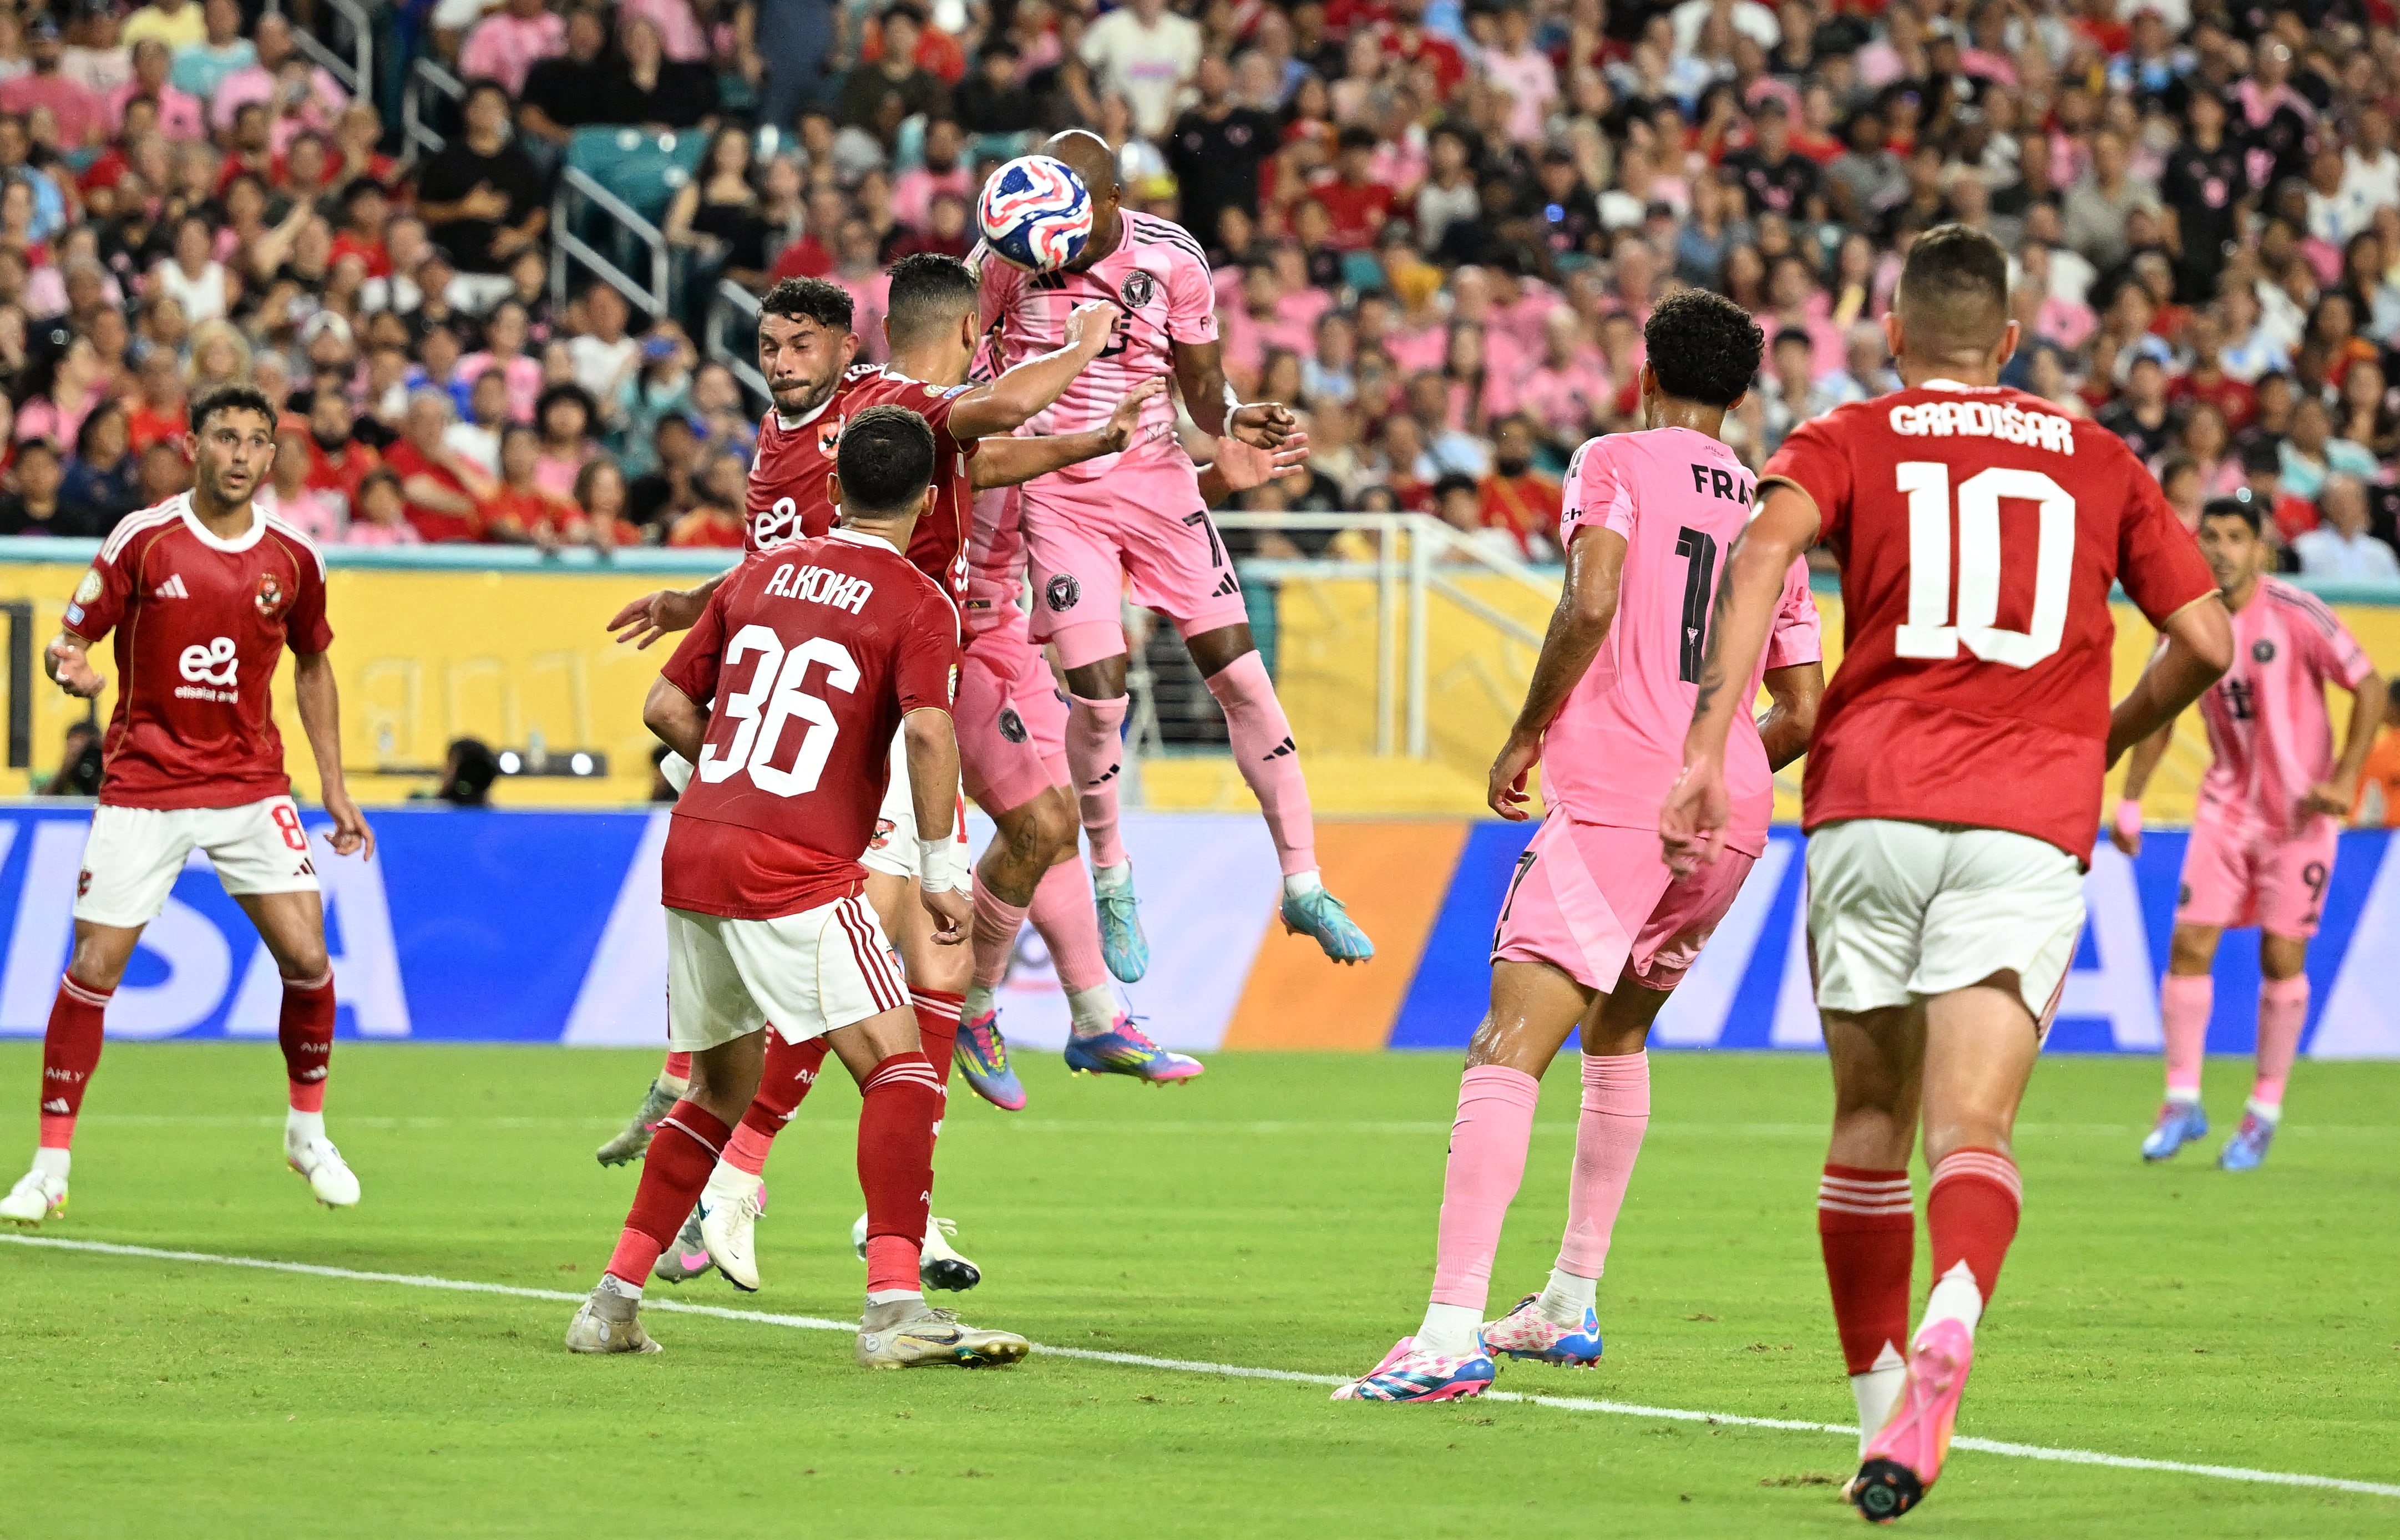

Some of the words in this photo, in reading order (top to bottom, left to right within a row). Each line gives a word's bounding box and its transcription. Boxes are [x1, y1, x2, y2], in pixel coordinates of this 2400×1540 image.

[1888, 401, 2075, 456] GRADIŠAR
[1181, 510, 1222, 568] 7
[1895, 461, 2075, 670] 10
[764, 563, 874, 615] A.KOKA
[1675, 525, 1732, 686] 1
[698, 624, 861, 798] 36
[272, 804, 306, 850] 8
[2302, 860, 2326, 903] 9
[44, 1066, 85, 1083] AHLY
